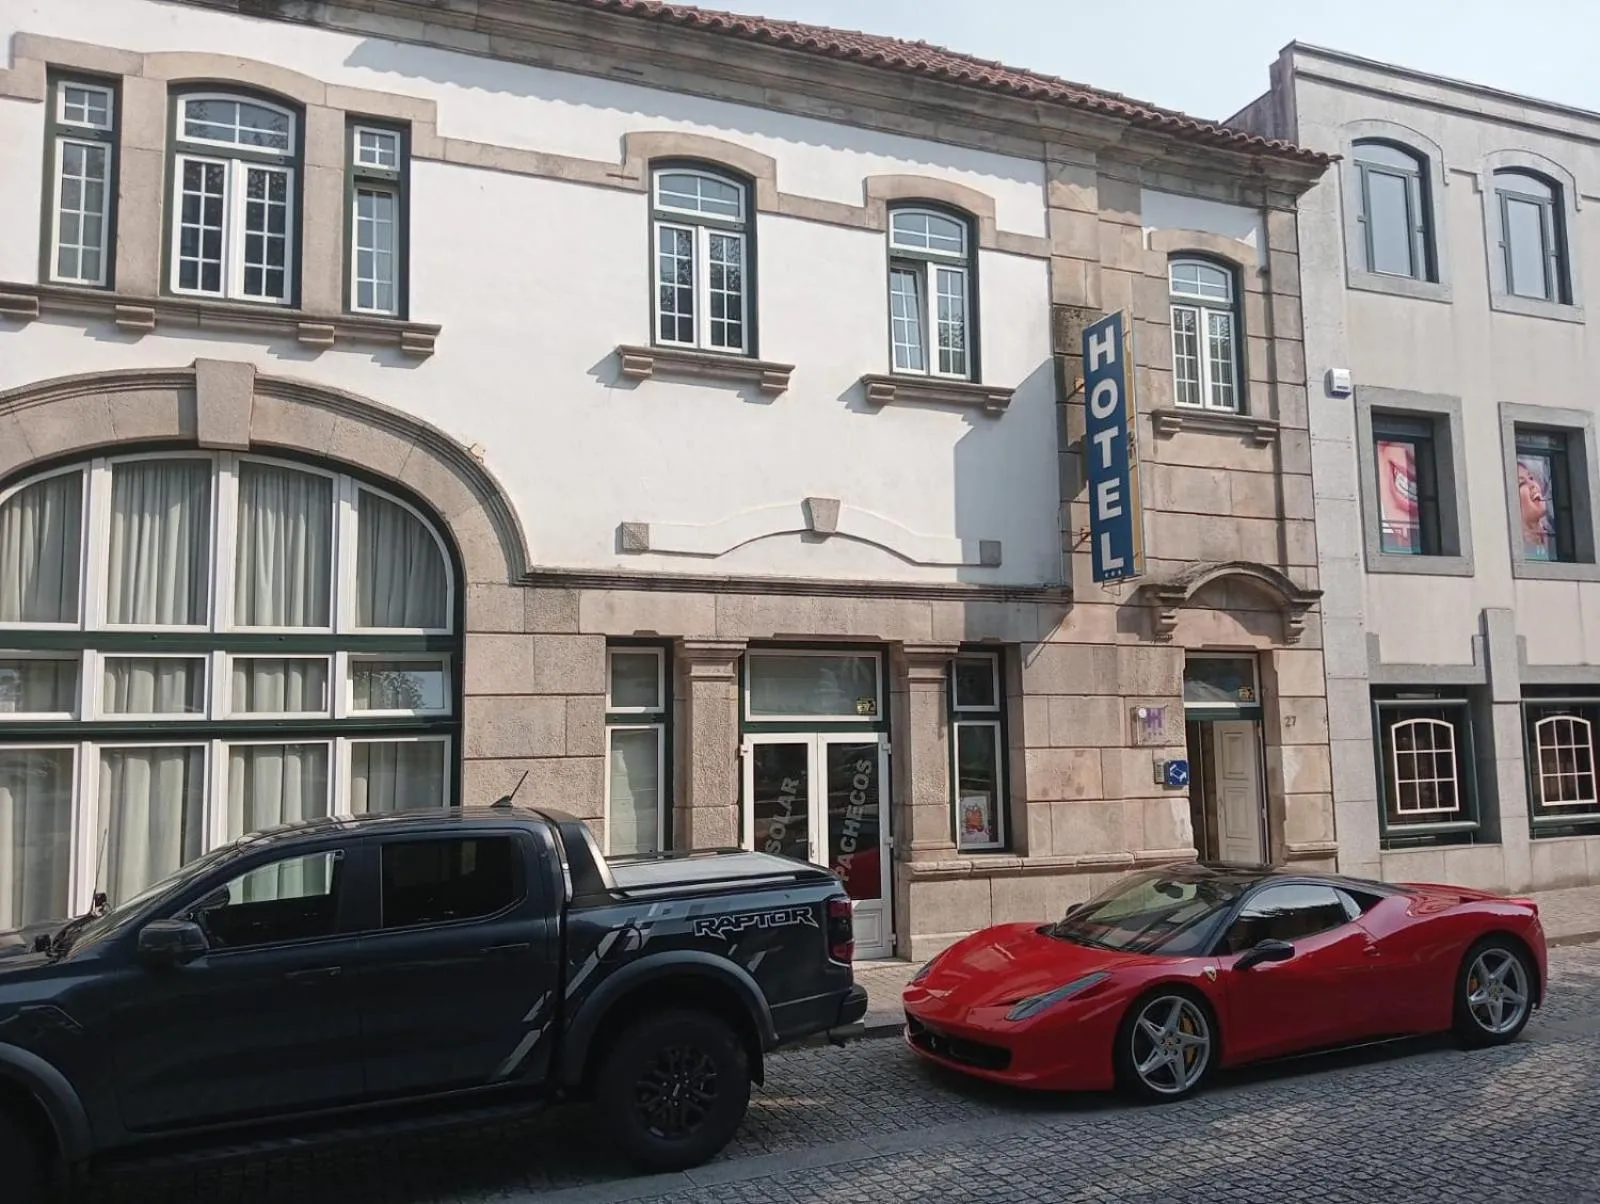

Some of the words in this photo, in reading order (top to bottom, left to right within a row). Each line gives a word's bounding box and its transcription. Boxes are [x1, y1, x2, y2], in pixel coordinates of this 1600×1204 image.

[1088, 325, 1124, 570] HOTEL
[1285, 716, 1297, 727] 27
[765, 777, 800, 853] SOLAR
[834, 760, 872, 881] PACHECOS
[693, 907, 819, 940] RAPTOR
